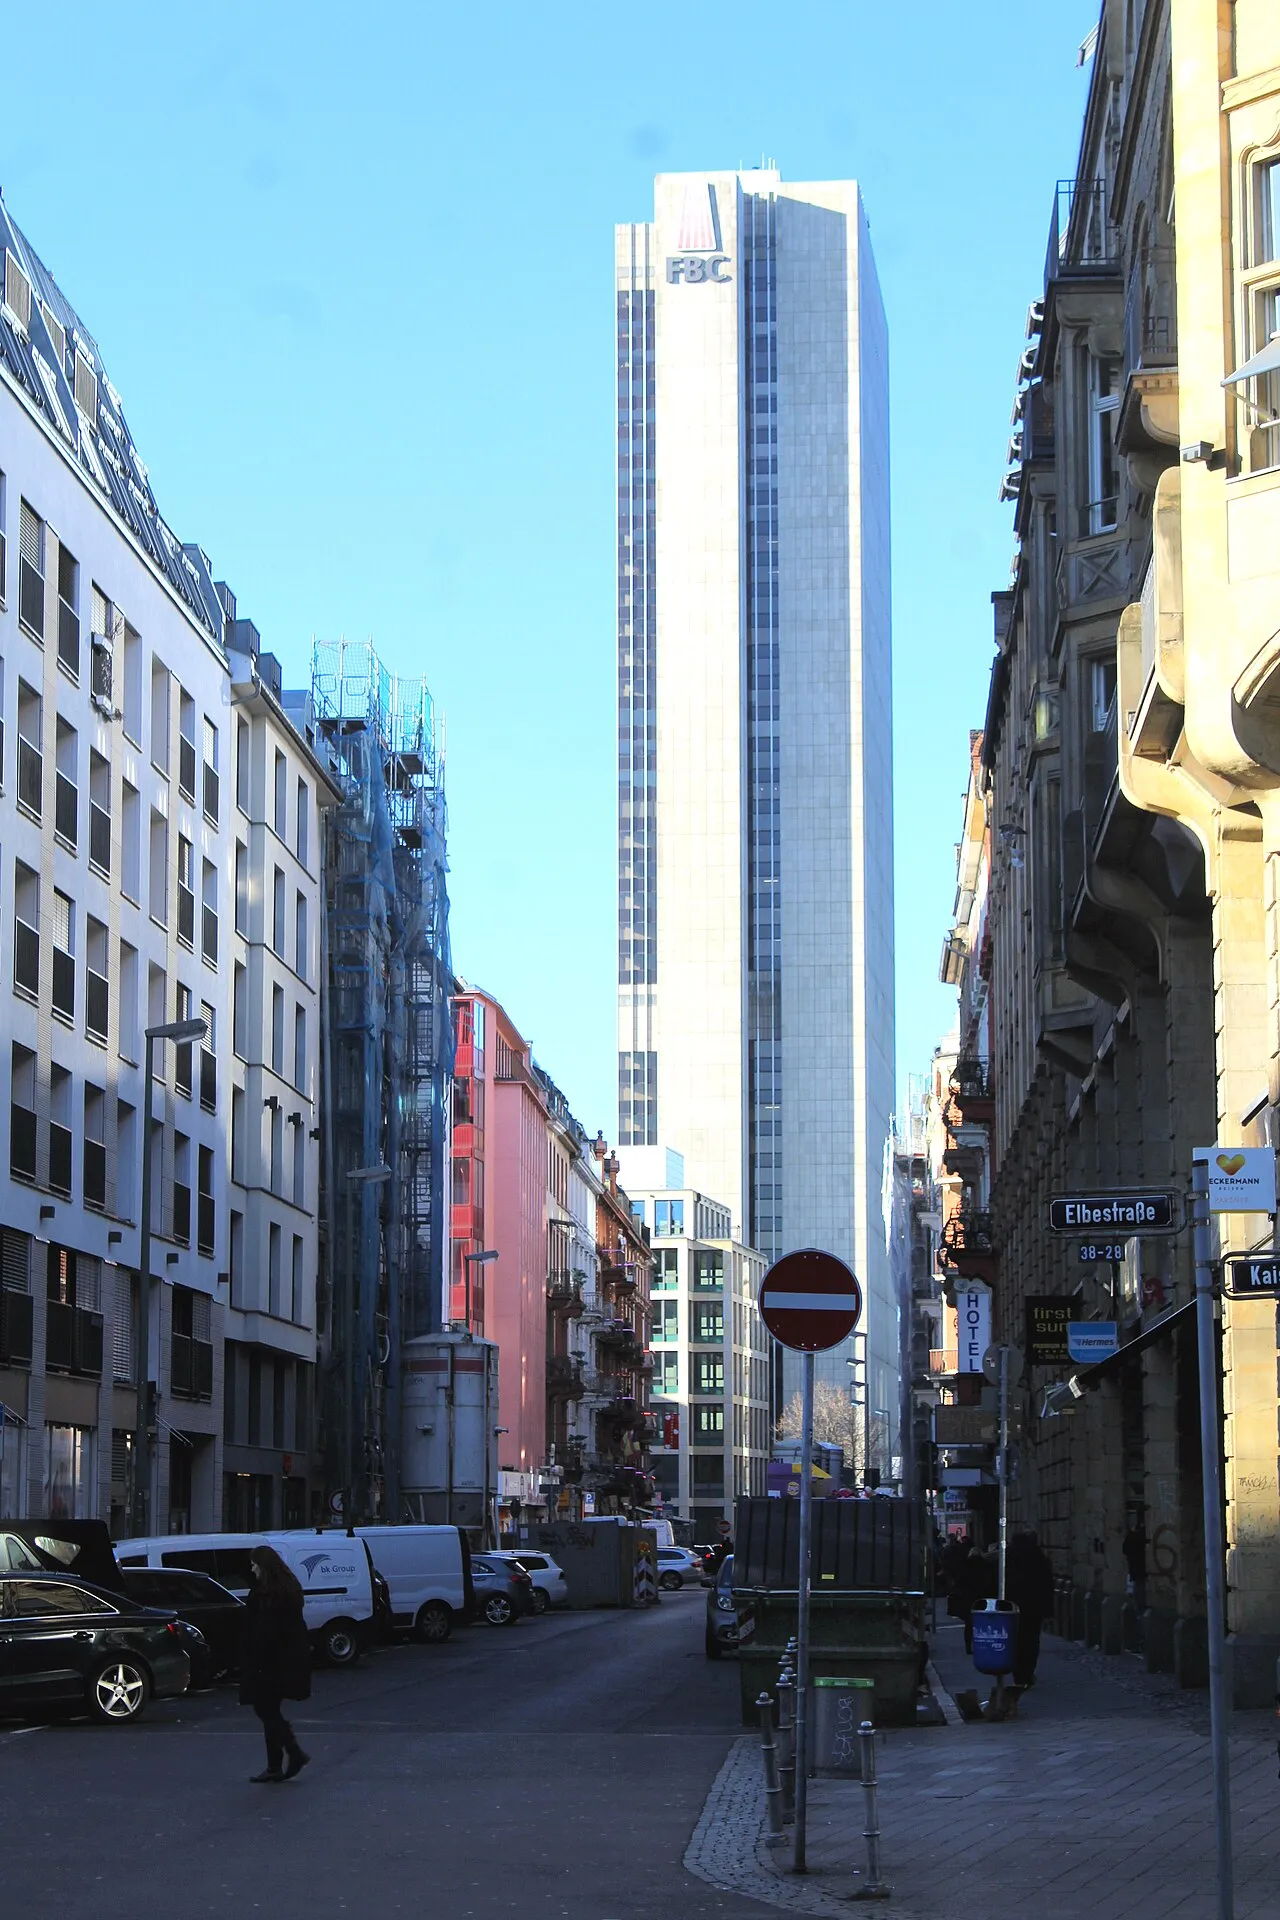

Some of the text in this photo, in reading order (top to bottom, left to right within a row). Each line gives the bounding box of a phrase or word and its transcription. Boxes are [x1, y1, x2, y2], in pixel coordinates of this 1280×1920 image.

[665, 255, 733, 284] FBC
[1065, 1201, 1156, 1224] Elbestraße
[1080, 1245, 1122, 1260] 38-28
[1250, 1265, 1280, 1286] Kai
[1033, 1307, 1073, 1319] first
[966, 1294, 980, 1372] HOTEL
[1081, 1338, 1115, 1346] Hermes
[332, 1565, 356, 1573] Group
